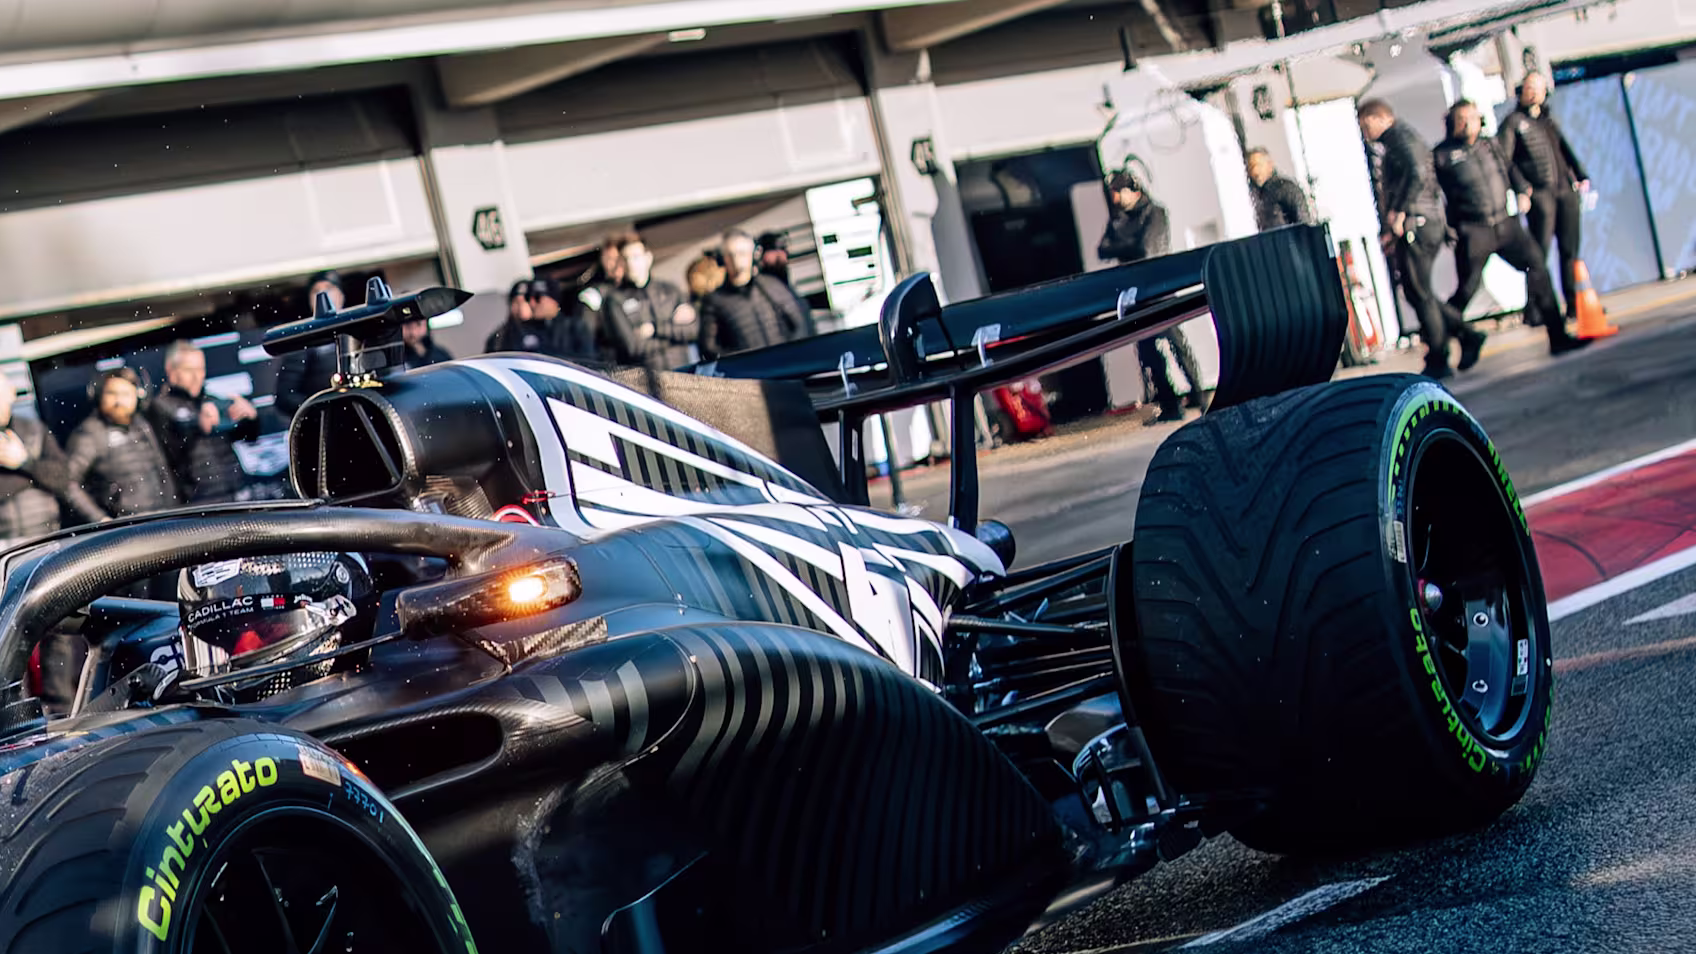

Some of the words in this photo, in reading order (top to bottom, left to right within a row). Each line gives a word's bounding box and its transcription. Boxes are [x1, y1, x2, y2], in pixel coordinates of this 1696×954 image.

[188, 596, 254, 623] CADILLAC
[230, 606, 254, 616] TEAM
[137, 756, 278, 942] Cinturato
